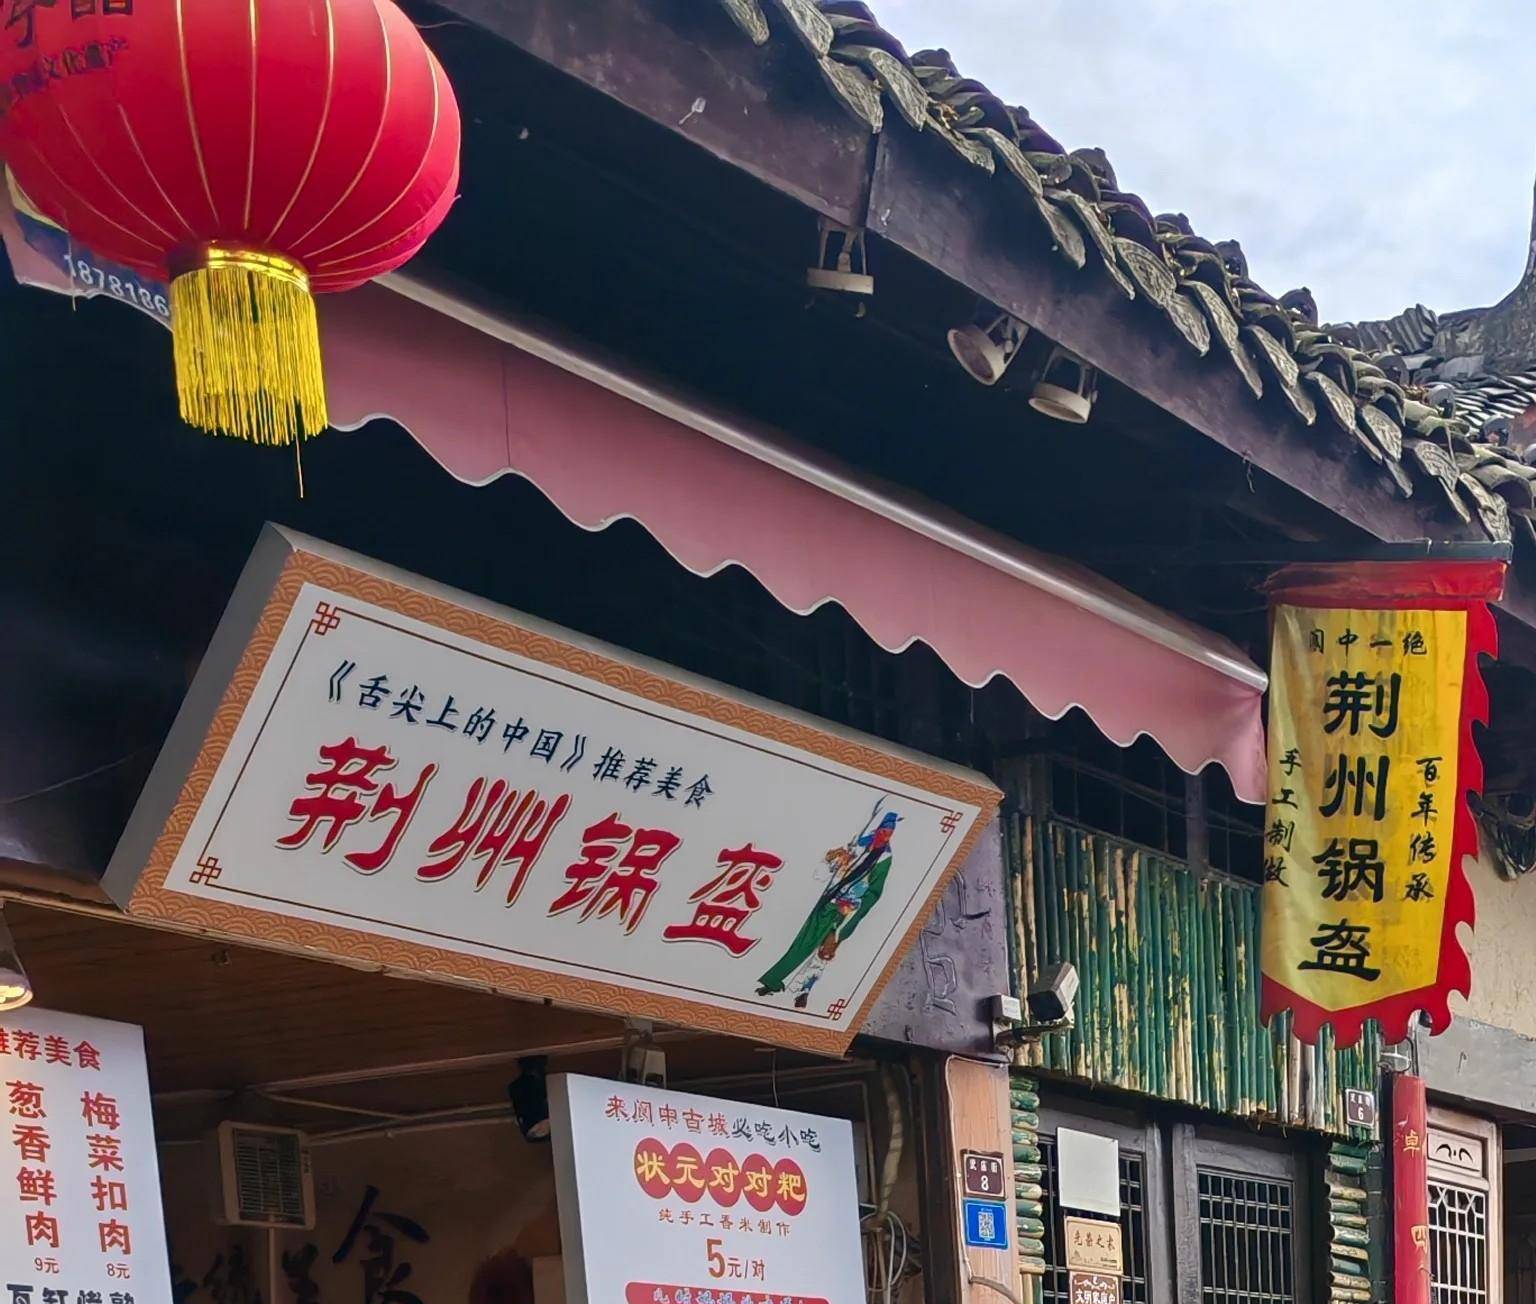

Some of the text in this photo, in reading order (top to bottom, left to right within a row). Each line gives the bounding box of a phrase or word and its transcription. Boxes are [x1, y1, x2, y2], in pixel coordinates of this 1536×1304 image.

[327, 659, 716, 810] 《舌尖上的中国》推荐美食
[275, 736, 784, 957] 荆州锅盔
[1298, 671, 1400, 981] 荆州锅盔
[1404, 756, 1442, 901] 百年传承
[1358, 1107, 1364, 1120] 6
[5, 1079, 59, 1248] 葱香鲜肉
[80, 1091, 131, 1255] 梅菜扣肉
[636, 1150, 806, 1202] 状元对对粑
[981, 1175, 989, 1191] 8
[659, 1208, 792, 1237] 纯手工香米制作
[34, 1257, 60, 1274] 9元
[107, 1263, 130, 1279] 8元
[706, 1238, 765, 1280] 5元/对
